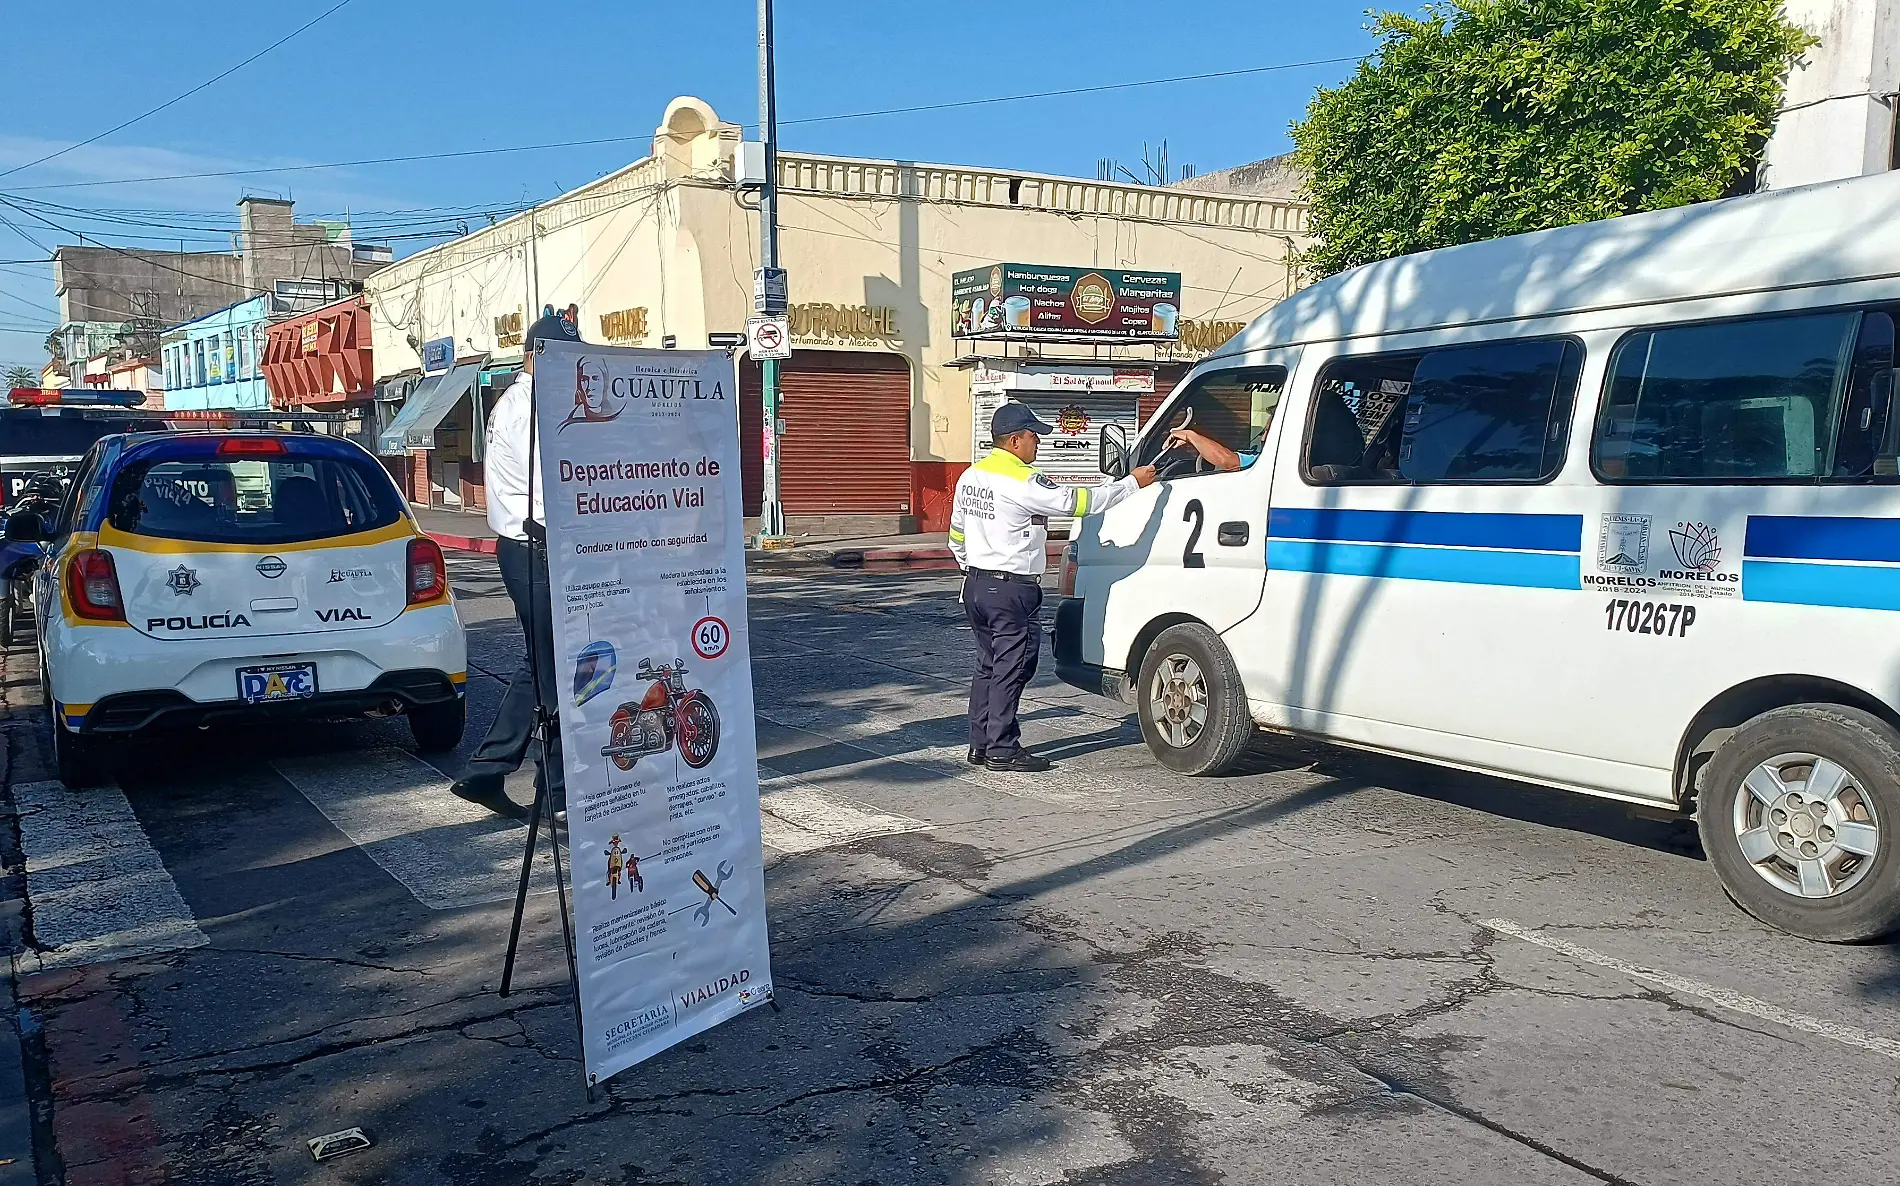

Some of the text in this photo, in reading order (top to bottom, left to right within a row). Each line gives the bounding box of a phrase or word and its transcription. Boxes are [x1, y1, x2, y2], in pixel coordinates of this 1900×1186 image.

[1007, 270, 1070, 282] Hamburguesas
[1122, 274, 1168, 284] Cervezas
[1019, 284, 1058, 294] Hot dogs
[1119, 287, 1174, 299] Margaritas
[1034, 298, 1065, 308] Nachos
[1120, 304, 1150, 314] Mojitos
[1037, 311, 1062, 320] Alitas
[635, 365, 660, 373] Heroica
[1052, 376, 1061, 385] El
[1063, 376, 1077, 386] Sol
[1077, 376, 1086, 386] de
[612, 376, 725, 400] CUAUTLA
[559, 456, 720, 487] Departamento de
[962, 485, 994, 500] POLICÍA
[576, 486, 704, 515] Educación Vial
[1183, 498, 1206, 568] 2
[575, 533, 708, 555] Conduce tu moto con seguridad
[257, 563, 287, 571] NISSAN
[1583, 575, 1657, 587] MORELOS
[1659, 569, 1739, 583] MORELOS
[1597, 586, 1647, 594] 2018-2024
[147, 609, 252, 632] POLICÍA
[314, 607, 372, 623] VIAL
[1605, 598, 1696, 638] 170267P
[700, 624, 720, 645] 60
[596, 791, 606, 799] con
[662, 838, 671, 846] No
[680, 969, 750, 1009] VIALIDAD
[605, 1004, 669, 1041] SECRETARÍA
